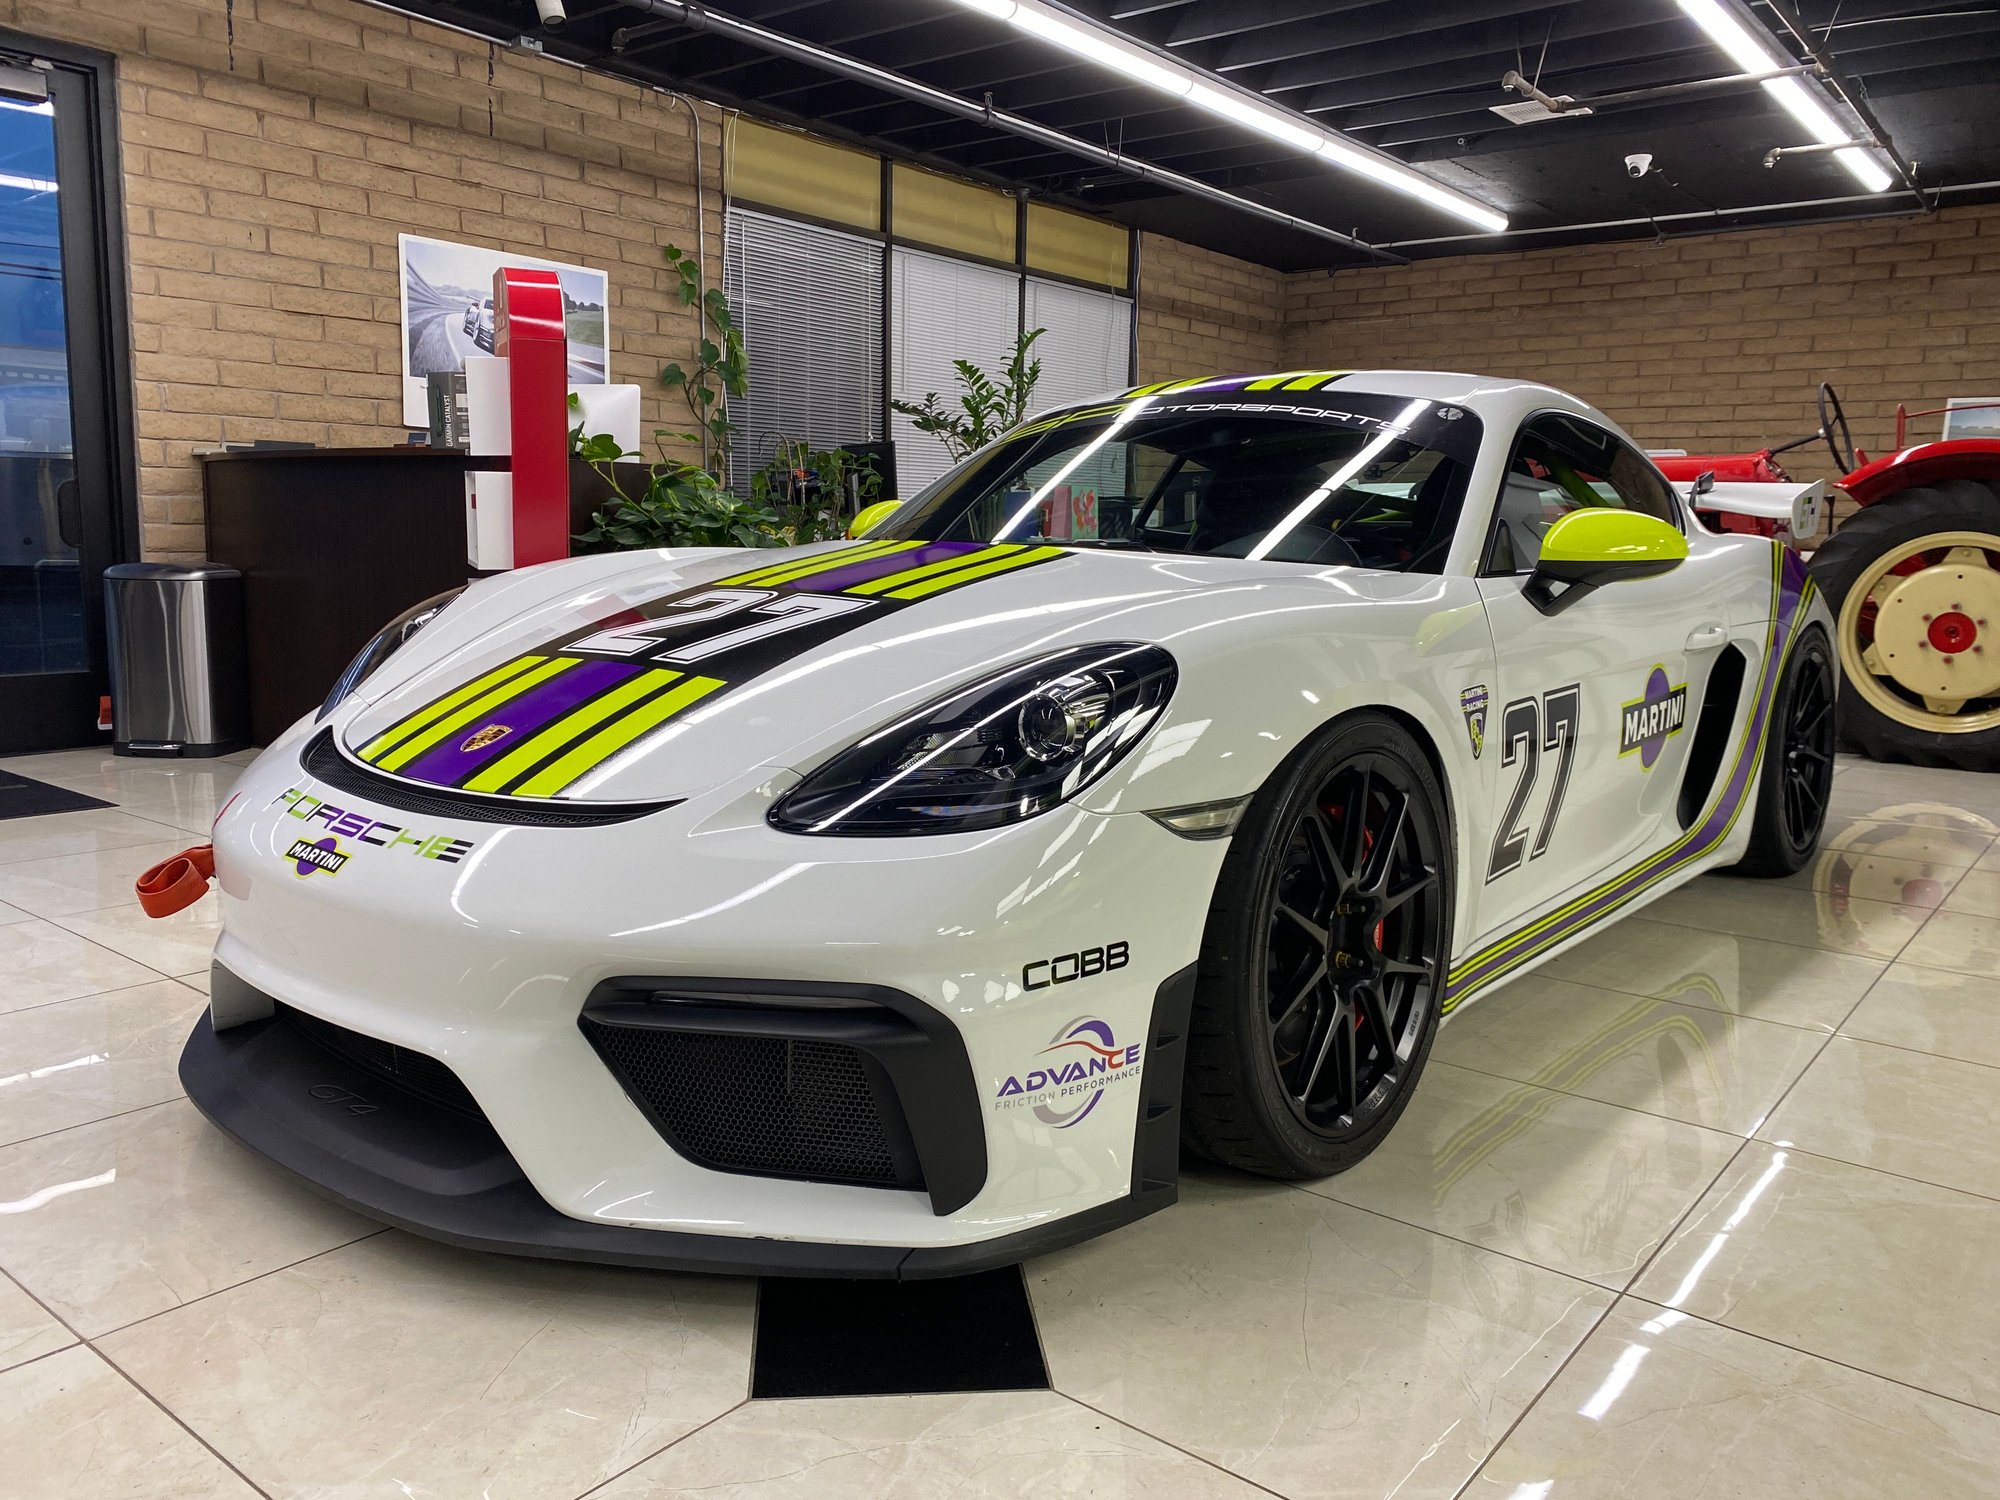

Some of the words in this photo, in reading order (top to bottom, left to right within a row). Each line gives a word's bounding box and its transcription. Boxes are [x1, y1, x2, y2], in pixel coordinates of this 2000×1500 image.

[558, 588, 881, 665] 27
[1624, 693, 1685, 746] MARTINI
[1485, 682, 1581, 887] 27
[271, 788, 475, 864] PORSCHE
[289, 843, 344, 871] MARTINI
[1022, 940, 1130, 992] COBB
[994, 1091, 1056, 1111] FRICTION
[1060, 1065, 1141, 1098] PERFORMANCE
[996, 1043, 1141, 1098] ADVANCE
